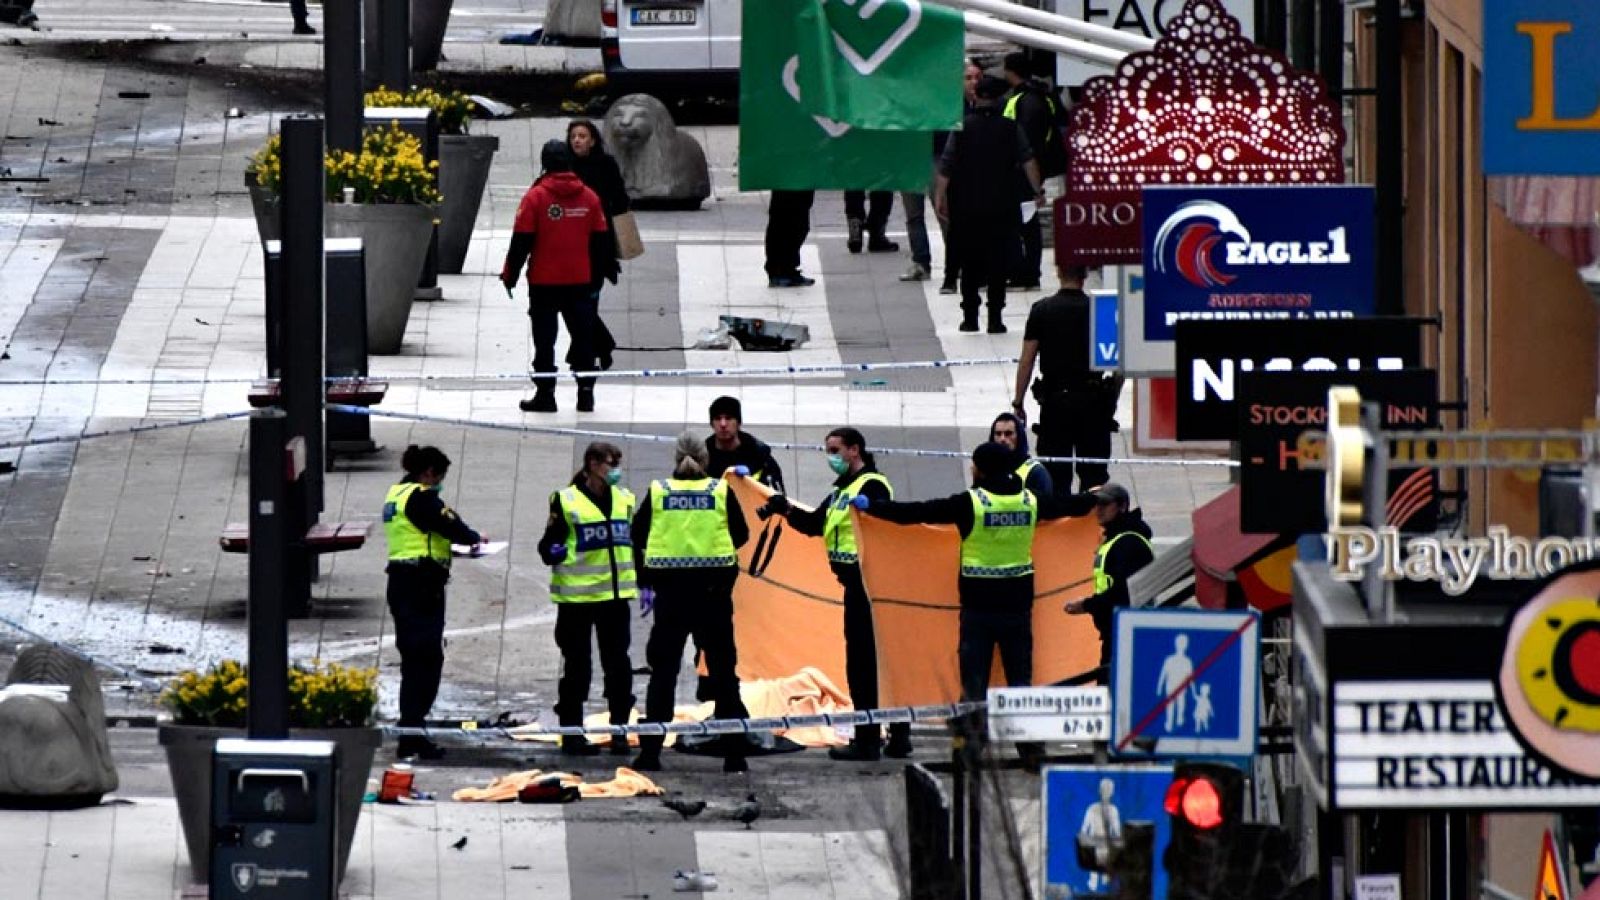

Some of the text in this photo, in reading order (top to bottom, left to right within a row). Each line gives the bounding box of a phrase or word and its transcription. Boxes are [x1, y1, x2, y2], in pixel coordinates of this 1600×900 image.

[1065, 202, 1143, 227] DRO
[1226, 227, 1350, 265] EAGLE1
[1387, 404, 1427, 424] INN
[668, 496, 709, 509] POLIS
[990, 513, 1027, 526] POLIS
[1062, 719, 1104, 735] 67-69
